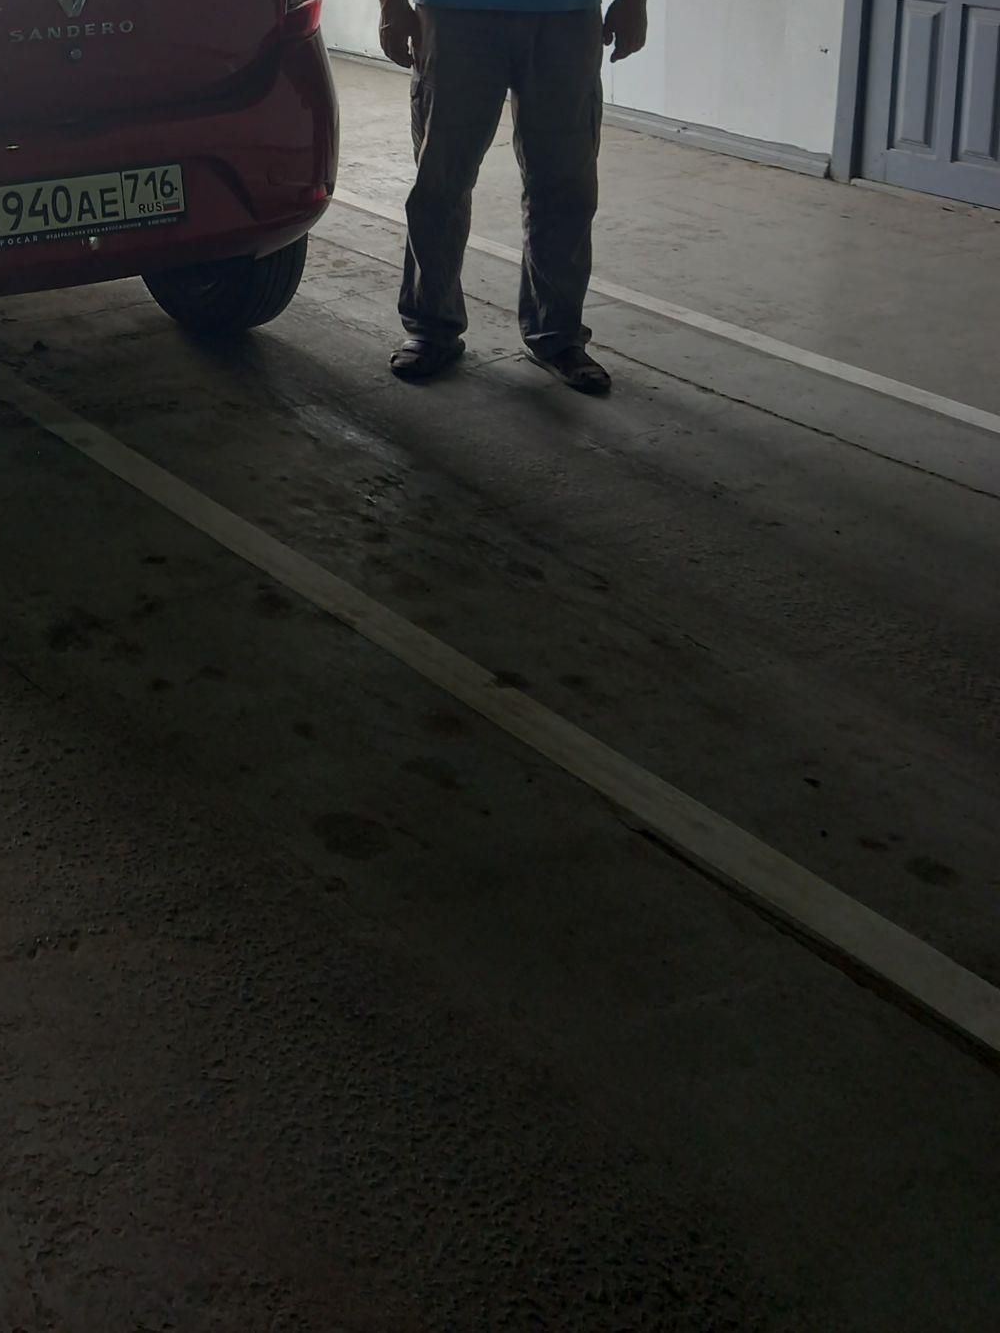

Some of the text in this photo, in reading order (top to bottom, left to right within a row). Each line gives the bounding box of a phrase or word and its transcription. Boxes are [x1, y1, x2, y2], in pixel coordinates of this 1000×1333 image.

[9, 20, 134, 43] SANDERO
[124, 169, 175, 204] 716
[138, 201, 162, 214] RUS
